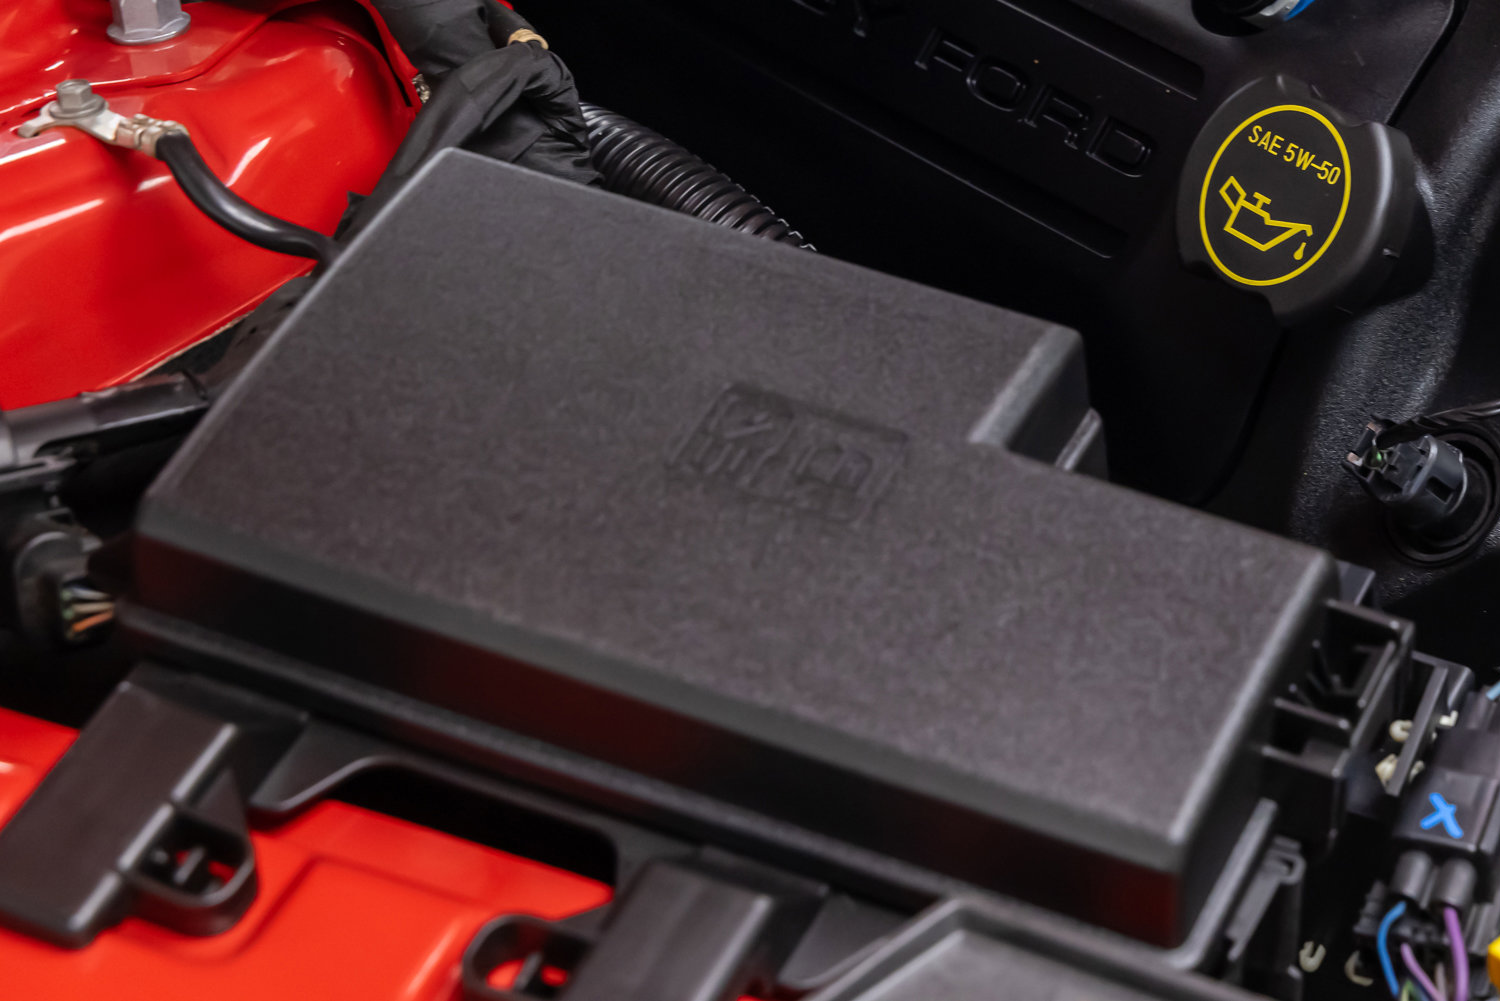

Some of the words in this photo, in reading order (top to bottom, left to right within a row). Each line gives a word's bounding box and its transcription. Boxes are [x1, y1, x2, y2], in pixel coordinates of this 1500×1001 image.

[914, 26, 1152, 178] FORD
[1248, 125, 1284, 155] SAE
[1284, 143, 1341, 185] 5W-50
